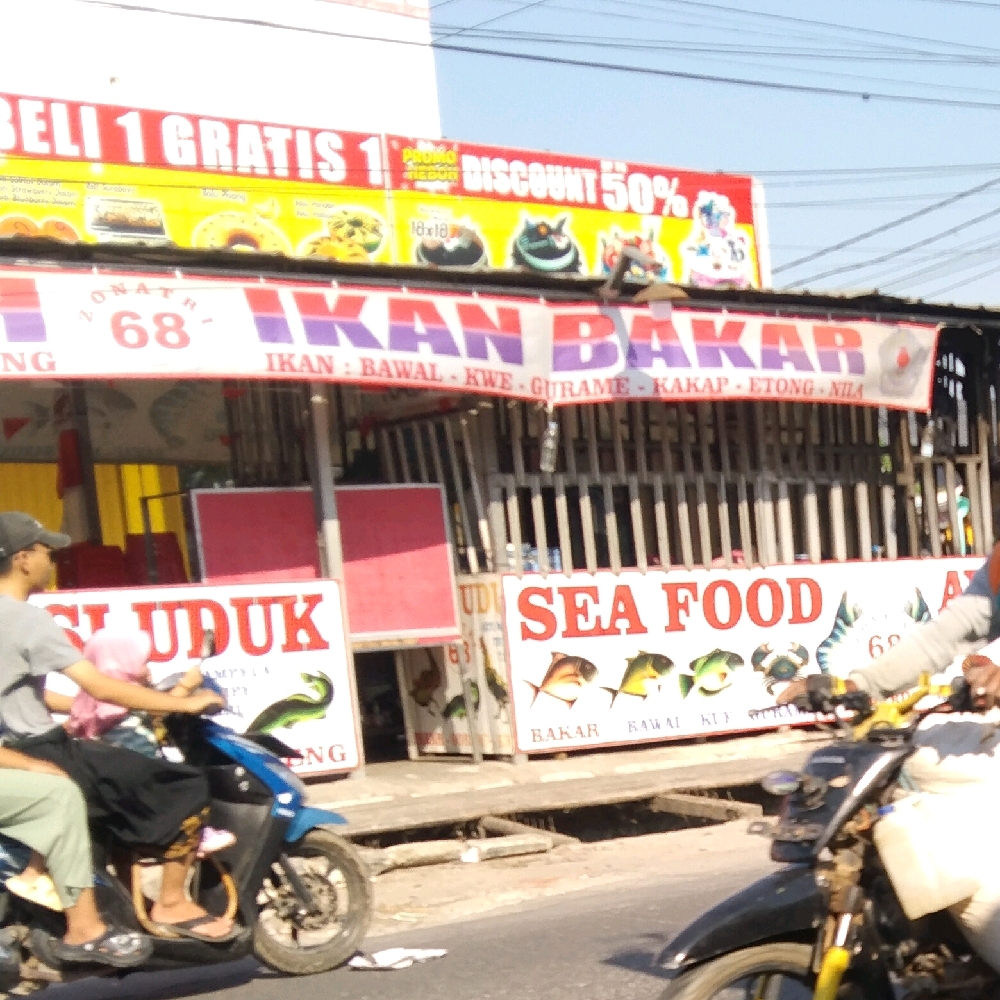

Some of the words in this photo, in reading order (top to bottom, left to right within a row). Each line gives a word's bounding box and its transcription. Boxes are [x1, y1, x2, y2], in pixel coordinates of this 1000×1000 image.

[116, 111, 145, 164] 1
[162, 115, 347, 182] GRATIS
[359, 136, 382, 185] 1
[461, 154, 598, 205] DISCOUNT
[601, 172, 689, 219] 50%
[110, 310, 191, 350] 68
[243, 287, 525, 367] IKAN
[552, 313, 866, 376] BAKAR
[265, 353, 335, 375] IKAN
[359, 357, 443, 383] BAWAL
[464, 366, 514, 391] KWE
[530, 377, 629, 402] GURAME
[653, 376, 729, 397] KAKAP
[750, 378, 814, 397] ETONG
[828, 381, 864, 399] NILA
[518, 585, 648, 641] SEA
[662, 577, 823, 633] FOOD
